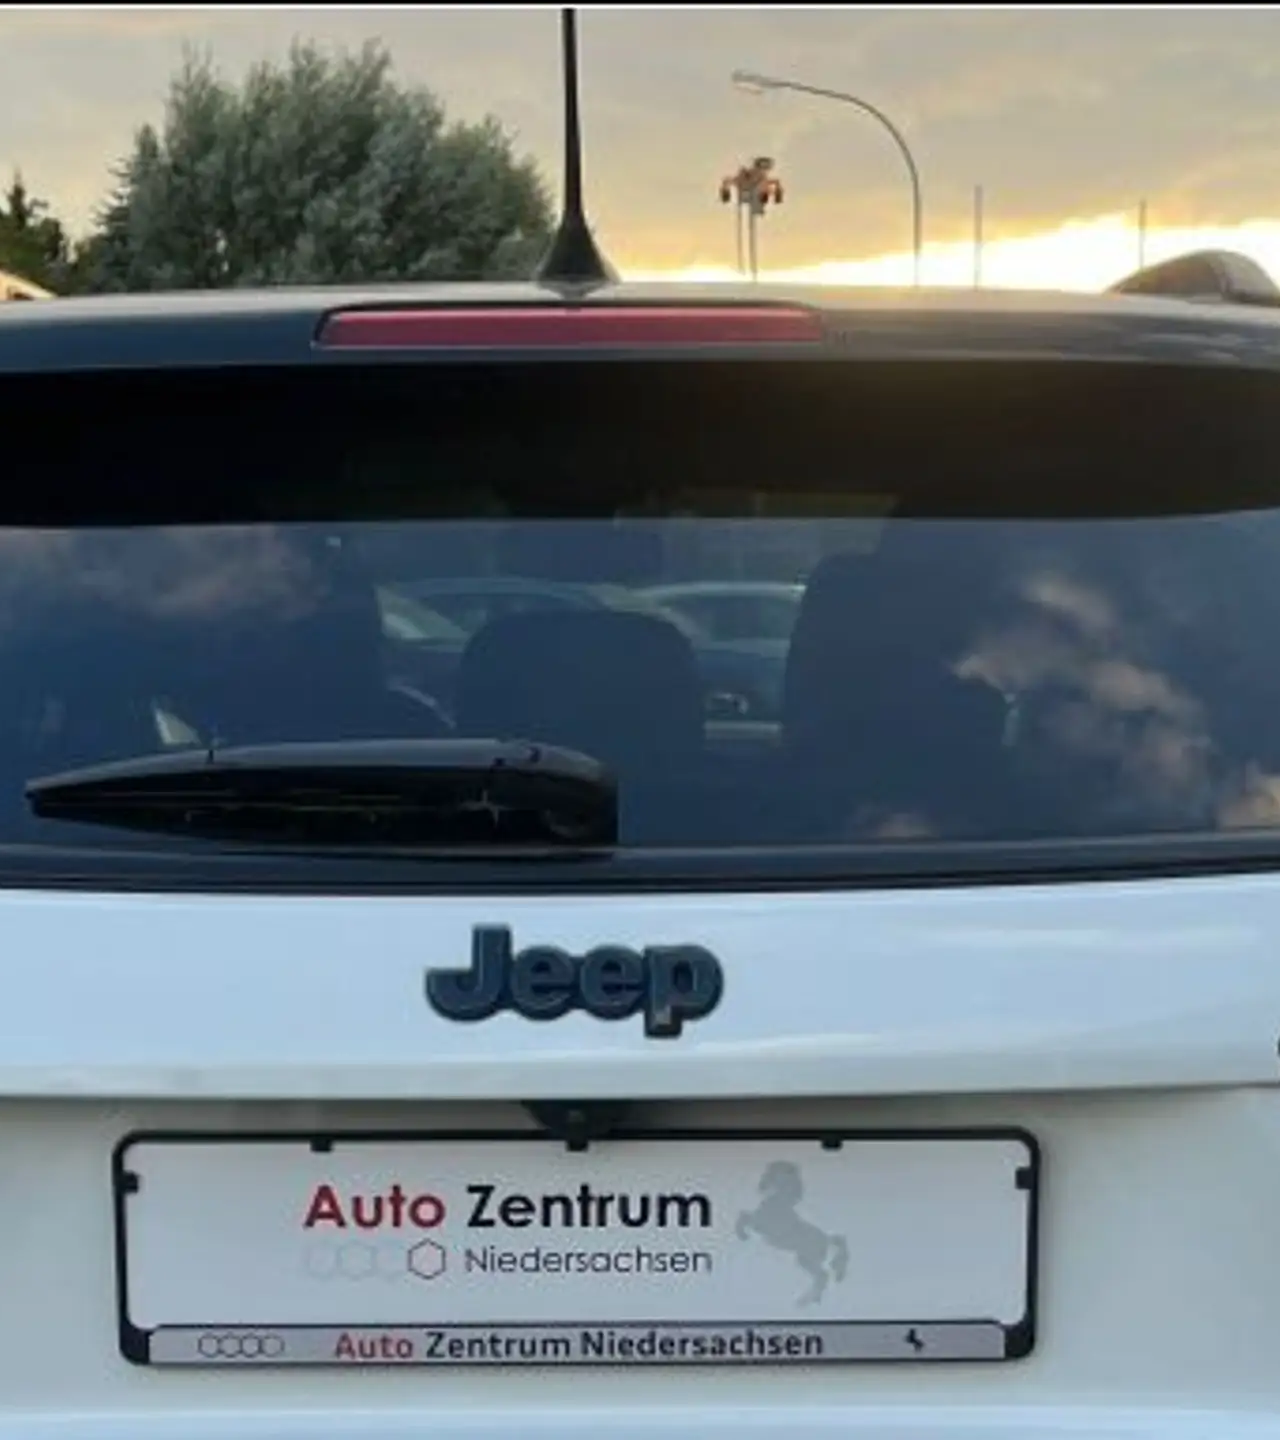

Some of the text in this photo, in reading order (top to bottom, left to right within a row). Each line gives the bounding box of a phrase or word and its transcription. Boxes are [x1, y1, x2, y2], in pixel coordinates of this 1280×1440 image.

[424, 923, 725, 1040] Jeep
[304, 1183, 712, 1230] Auto Zentrum
[464, 1245, 713, 1274] Niedersachsen
[334, 1328, 825, 1360] Auto Zentrum Niedersachsen
